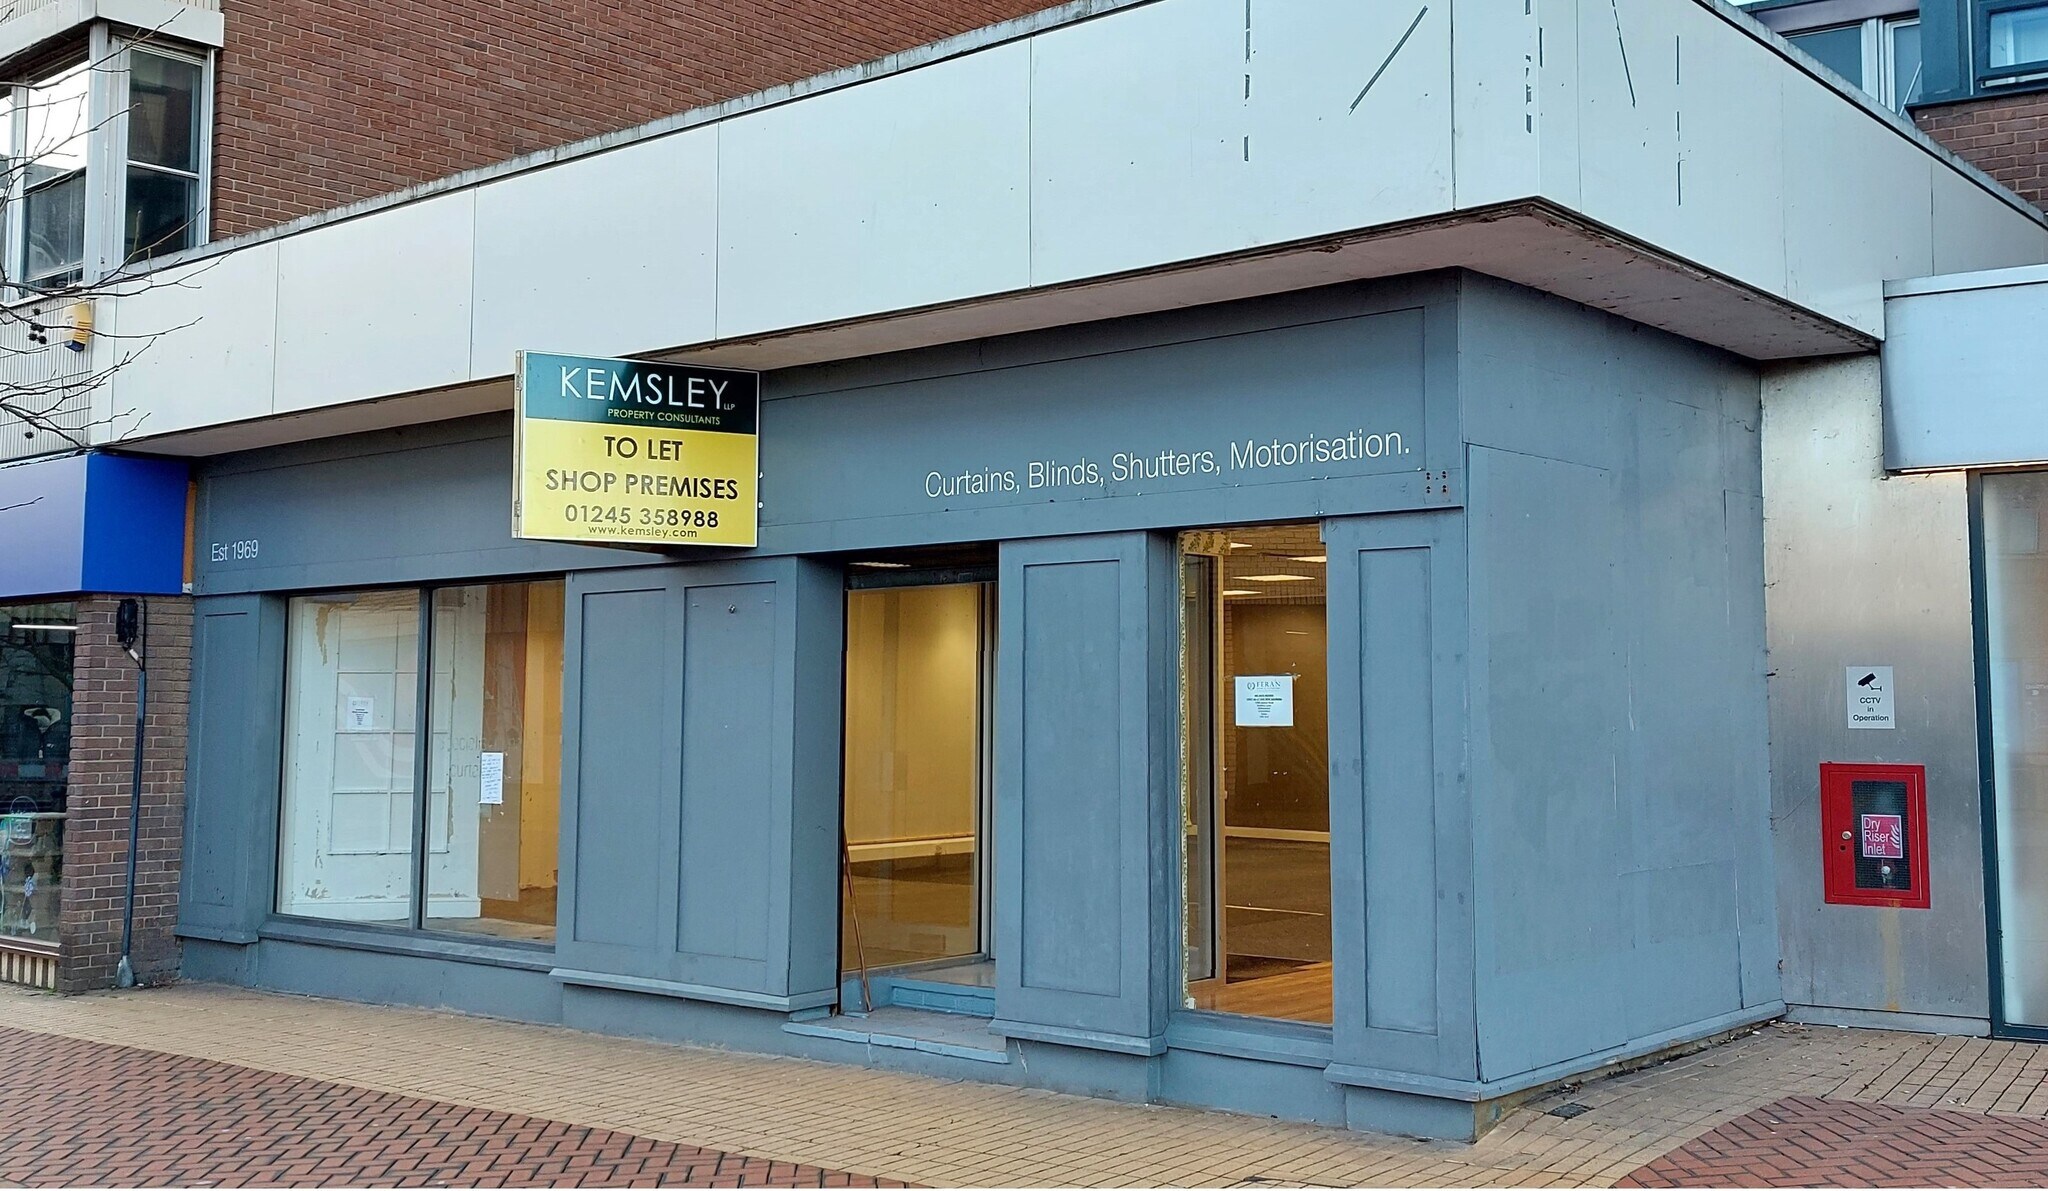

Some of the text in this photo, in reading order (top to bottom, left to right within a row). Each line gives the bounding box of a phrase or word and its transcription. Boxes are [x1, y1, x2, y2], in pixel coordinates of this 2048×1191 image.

[560, 366, 729, 410] KEMSLEY
[723, 403, 736, 411] LLP
[607, 408, 721, 426] PROPERTY CONSULTANTS
[603, 436, 684, 461] TO LET
[925, 428, 1410, 498] Curtains, Blinds, Shutters, Motorisation.
[545, 469, 739, 500] SHOP PREMISES
[565, 504, 719, 528] 01245 358988
[588, 525, 698, 539] www.kemsley.com
[211, 539, 259, 562] Est 1969
[1859, 697, 1882, 705] CCTV
[1852, 714, 1890, 723] Operation
[1863, 817, 1882, 833] Dry
[1864, 831, 1890, 844] Riser
[1864, 843, 1887, 856] Inlet
